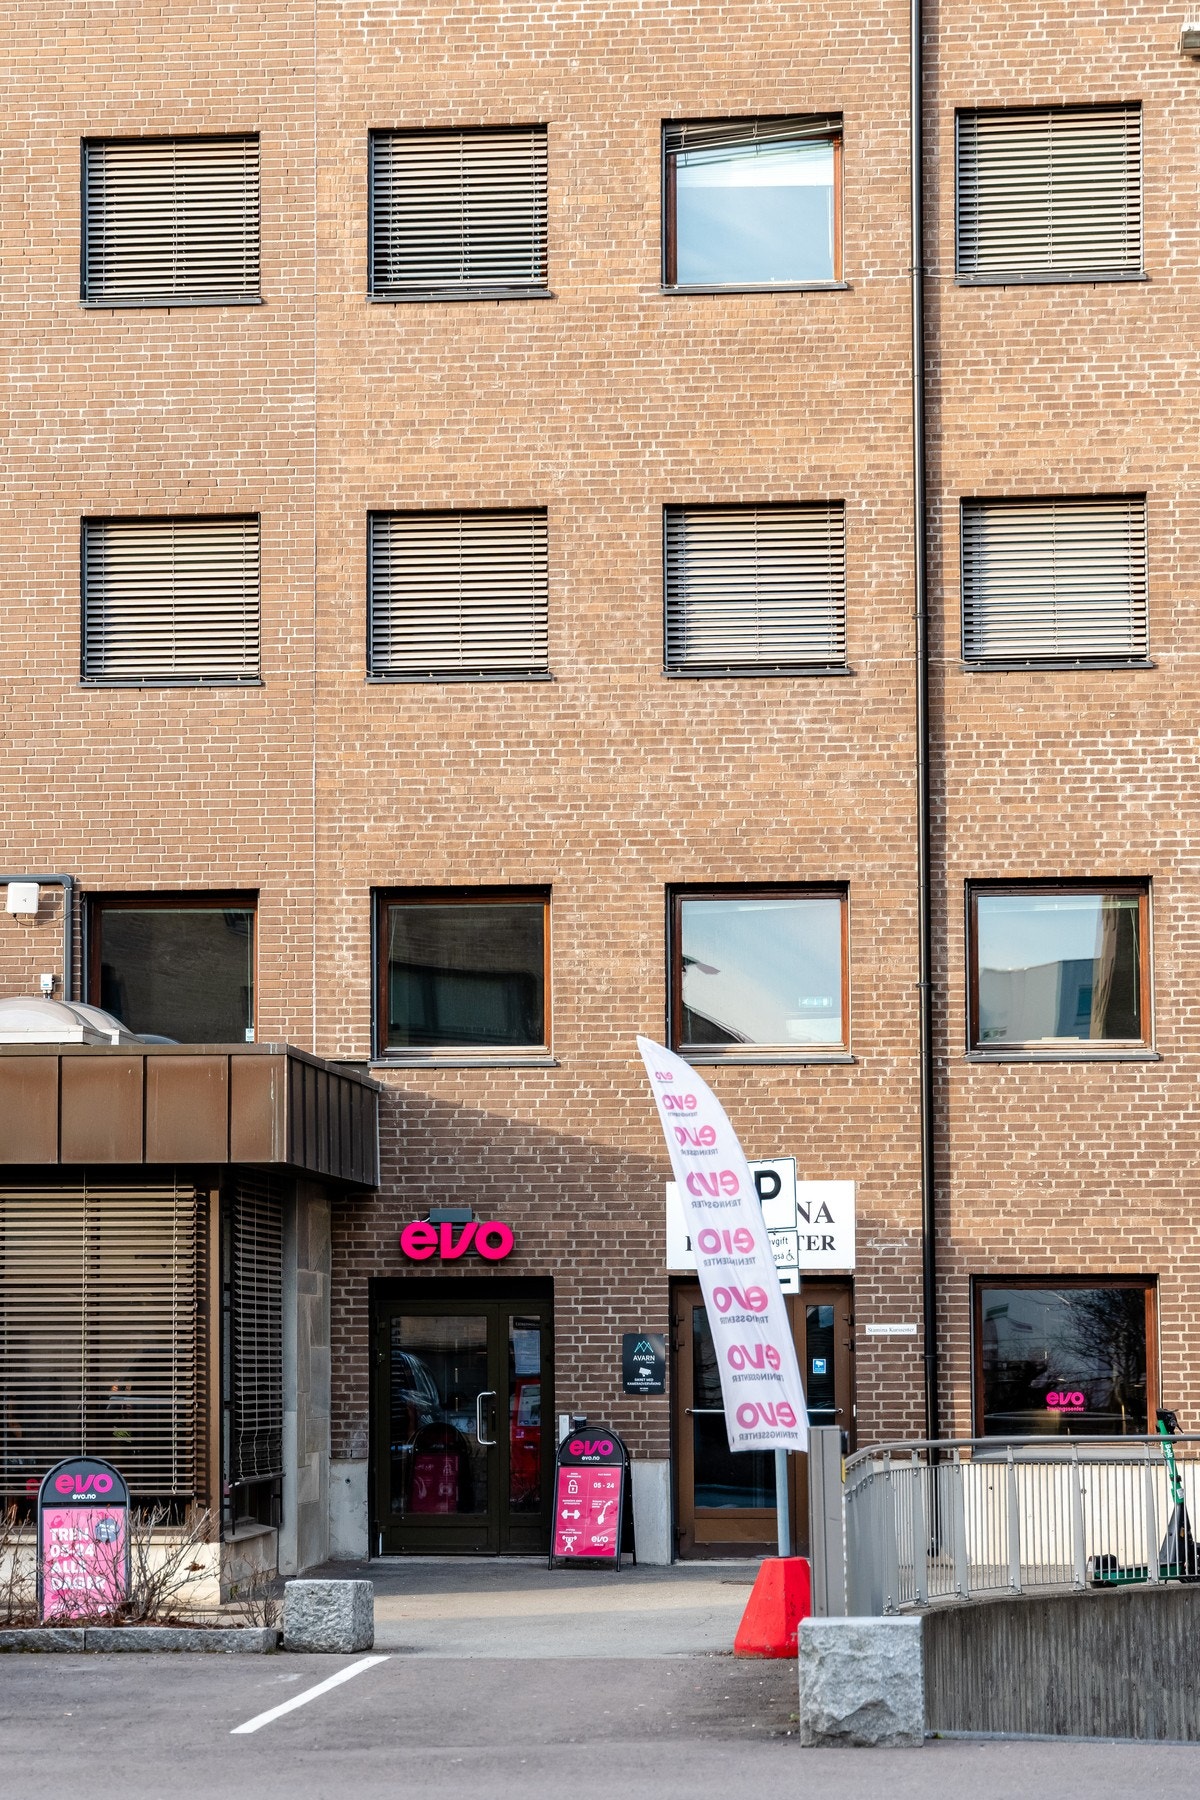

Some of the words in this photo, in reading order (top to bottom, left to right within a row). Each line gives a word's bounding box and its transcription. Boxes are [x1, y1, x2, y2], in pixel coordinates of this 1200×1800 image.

[754, 1169, 782, 1200] P
[400, 1220, 514, 1260] evo
[771, 1236, 788, 1247] vgift
[1046, 1391, 1085, 1405] evo
[569, 1439, 613, 1456] evo
[55, 1473, 113, 1494] evo
[50, 1528, 89, 1541] TREN
[591, 1535, 609, 1543] evo
[51, 1560, 87, 1574] ALLE
